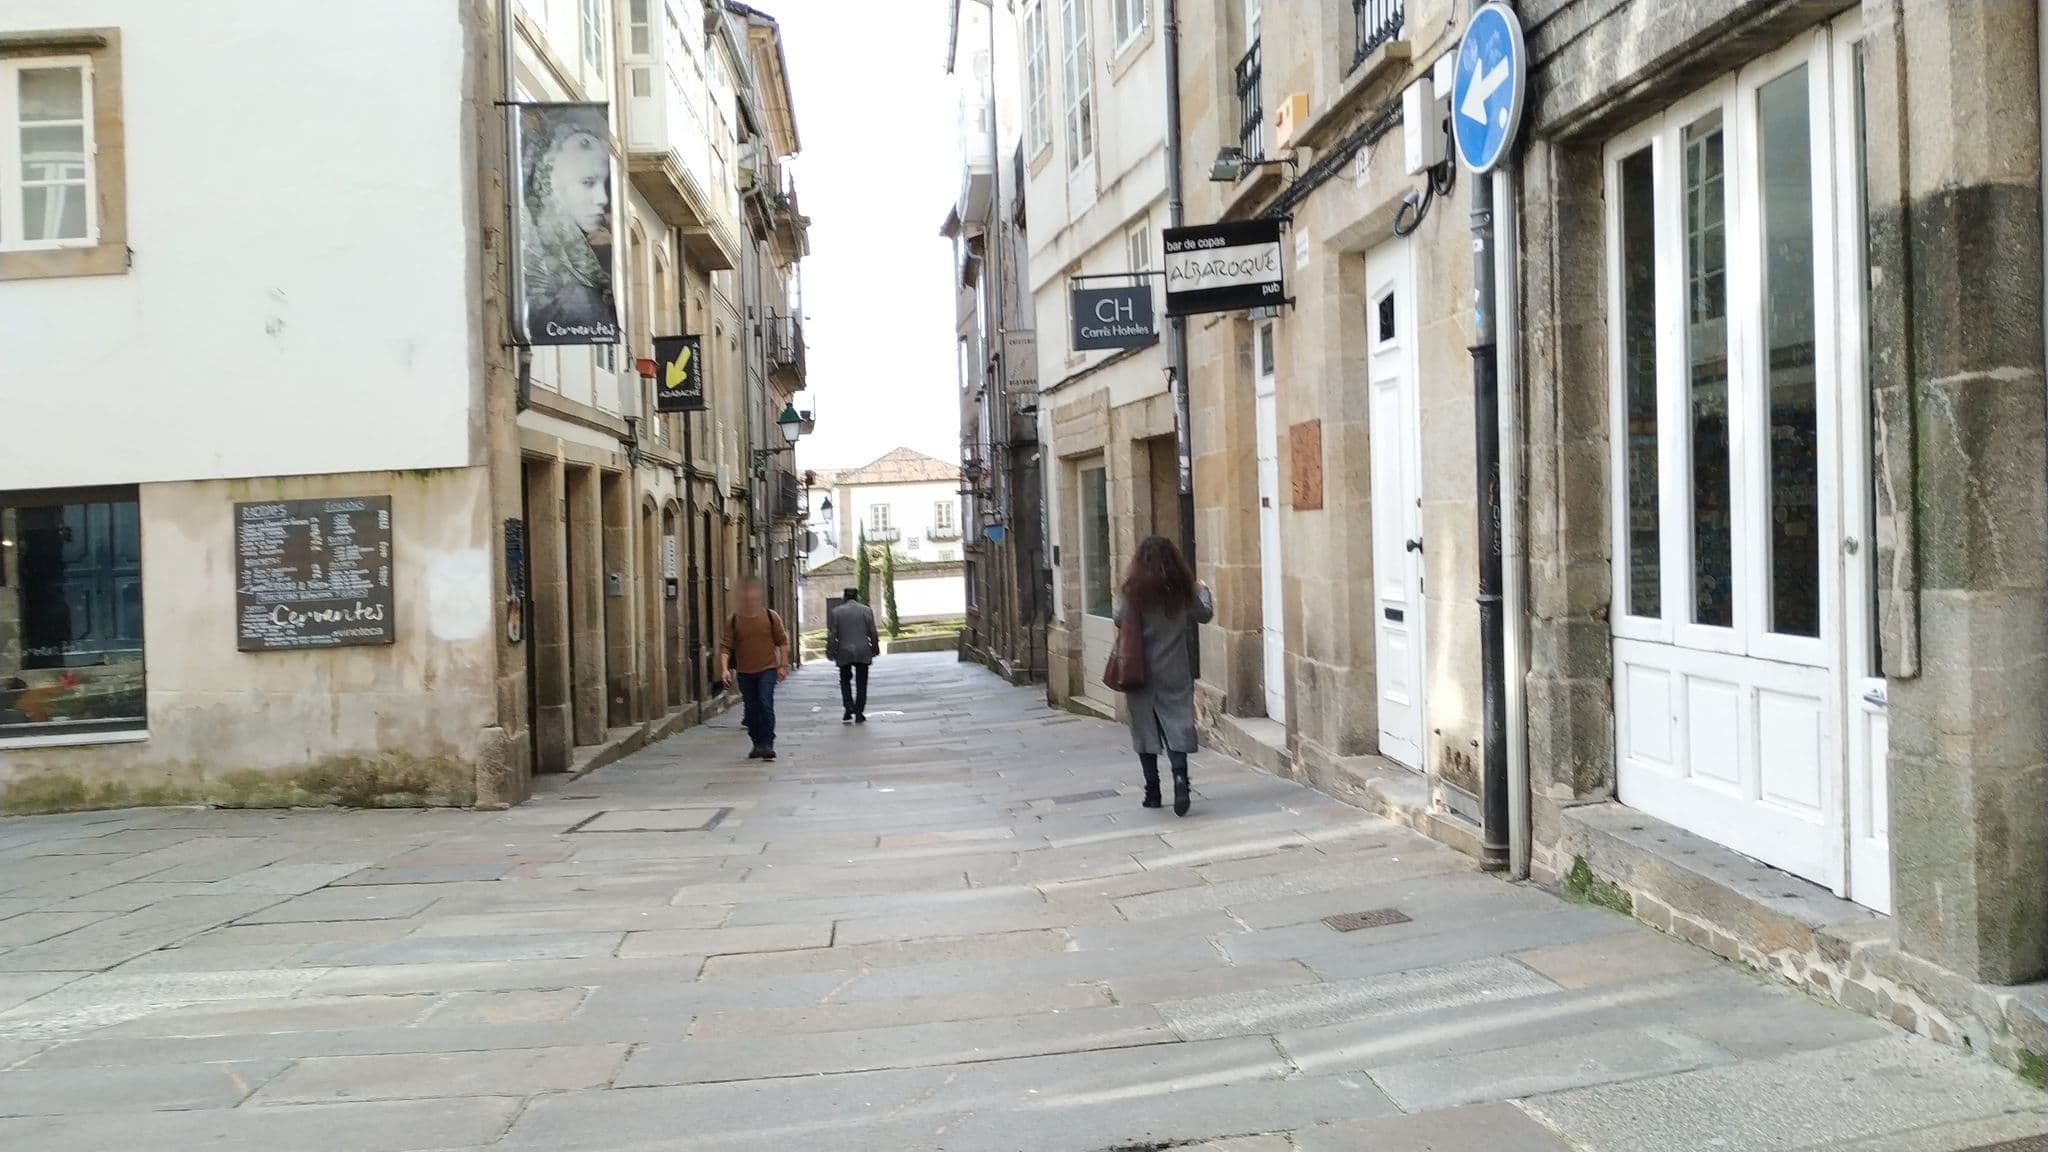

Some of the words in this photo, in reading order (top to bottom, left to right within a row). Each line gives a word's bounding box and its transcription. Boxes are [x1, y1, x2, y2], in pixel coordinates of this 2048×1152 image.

[1166, 240, 1183, 252] bar
[1183, 238, 1197, 250] de
[1197, 236, 1226, 249] copas
[1261, 281, 1280, 295] pub
[1095, 296, 1134, 323] CH
[1111, 322, 1149, 337] Hoteles
[273, 601, 384, 625] Cervantes
